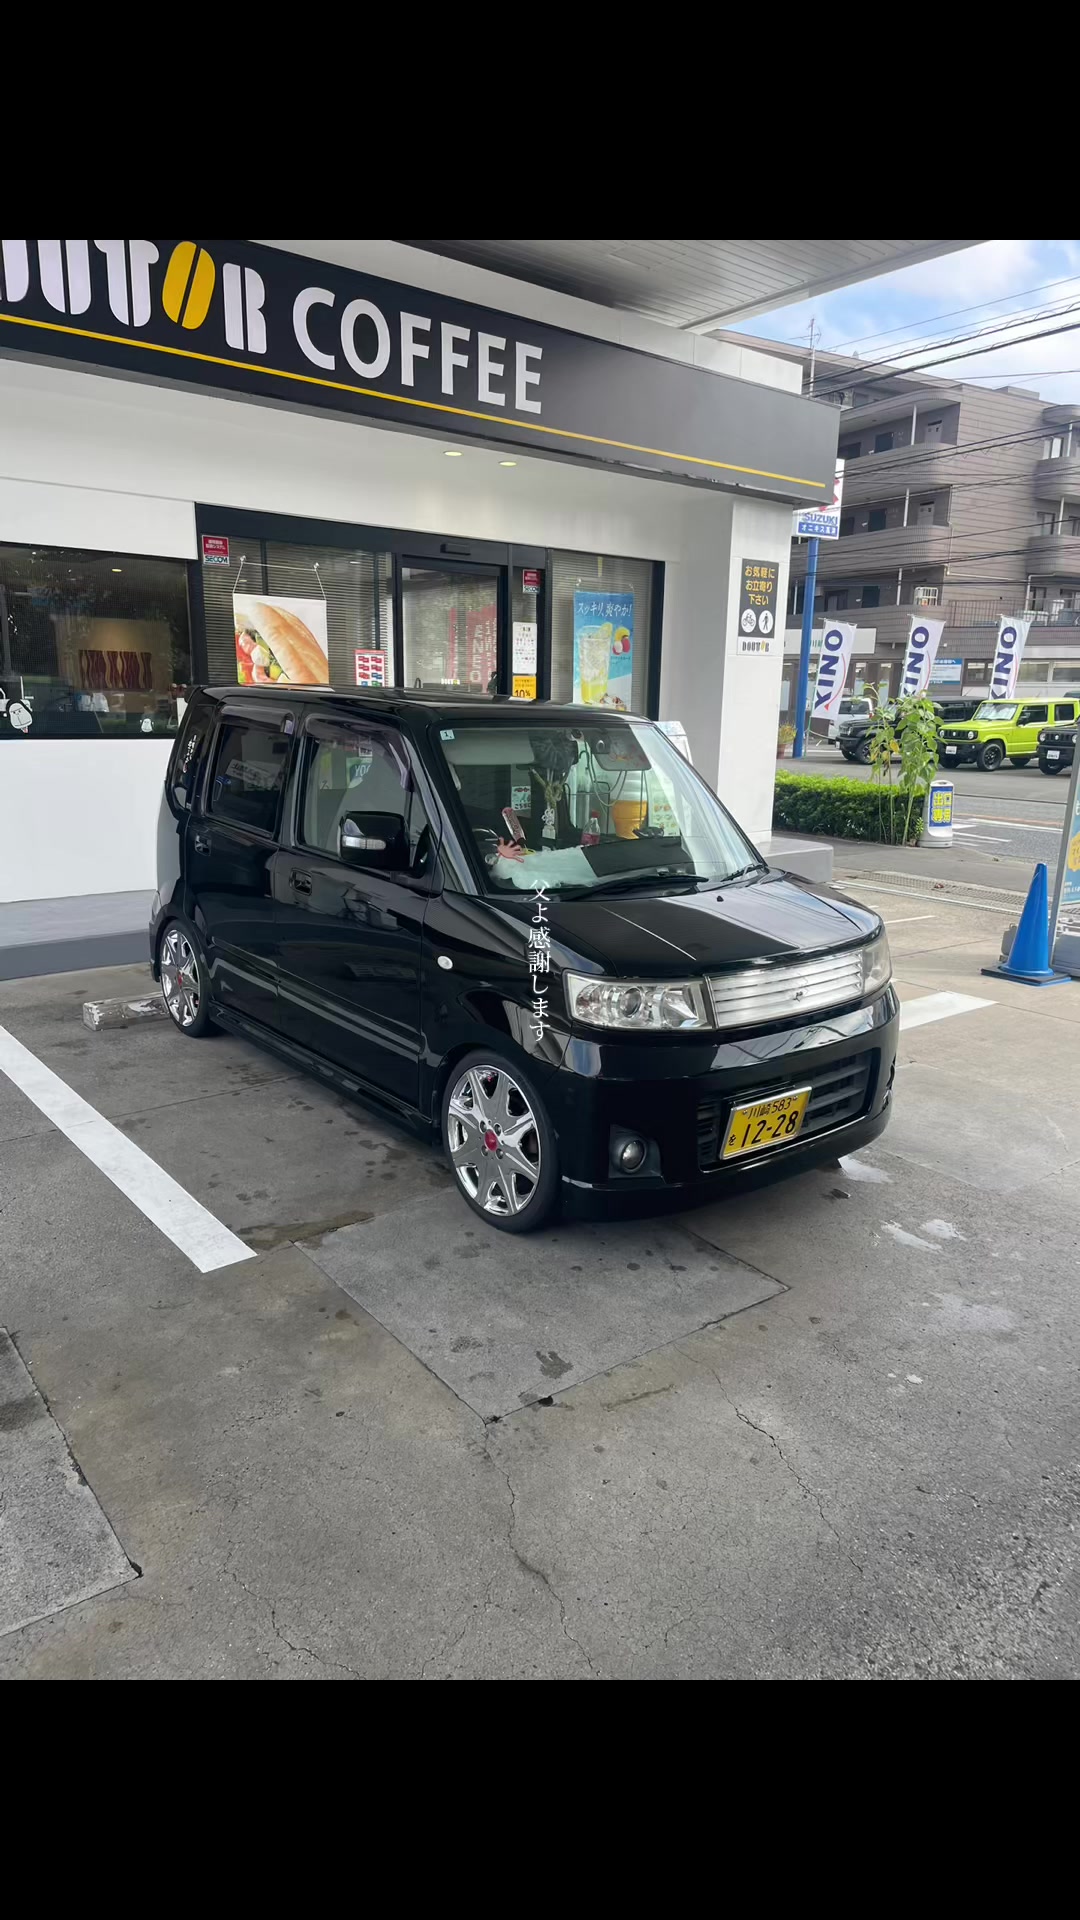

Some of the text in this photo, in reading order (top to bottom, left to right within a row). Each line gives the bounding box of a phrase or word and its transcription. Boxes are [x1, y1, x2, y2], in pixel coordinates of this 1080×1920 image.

[292, 287, 543, 414] COFFEE
[804, 512, 839, 526] SUZUKI
[205, 555, 228, 563] SECOM
[744, 566, 776, 579] お気軽に
[745, 580, 773, 593] お立寄り
[748, 593, 769, 606] 下さい
[742, 641, 769, 653] DOUTOR
[933, 791, 952, 807] 出口
[932, 808, 951, 824] 専用
[748, 1098, 792, 1120] 川崎 583
[741, 1111, 799, 1148] 12-28
